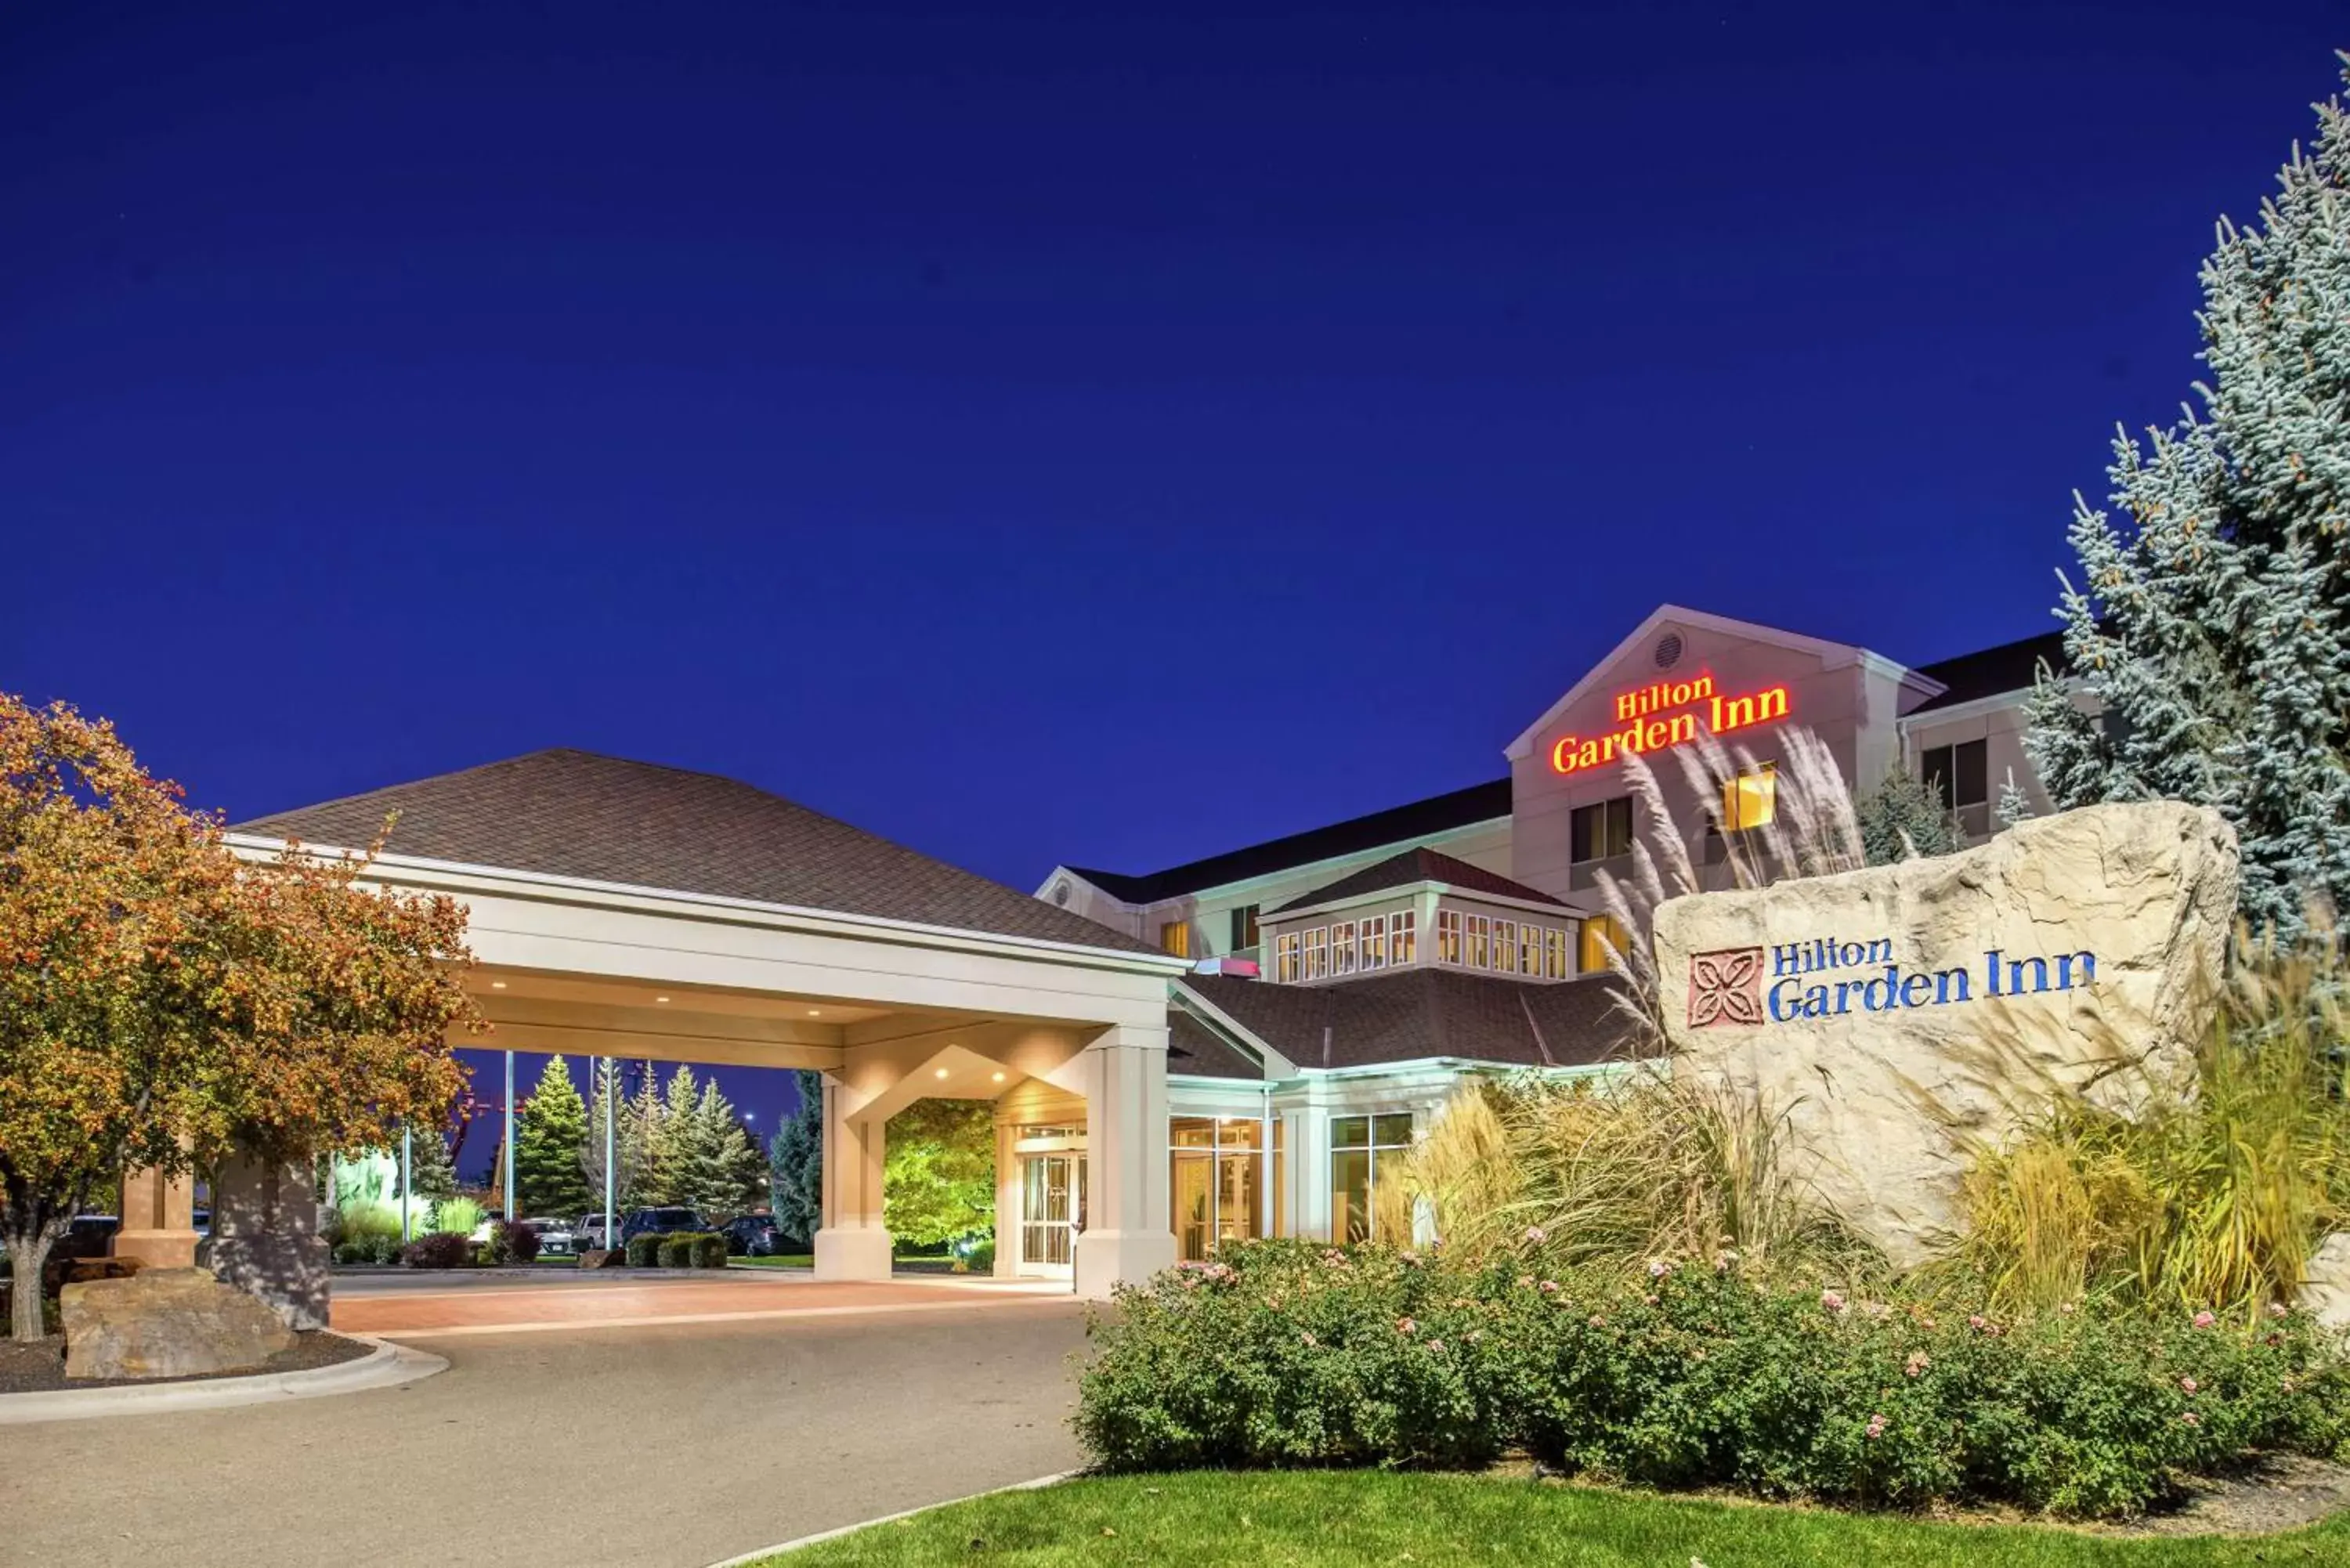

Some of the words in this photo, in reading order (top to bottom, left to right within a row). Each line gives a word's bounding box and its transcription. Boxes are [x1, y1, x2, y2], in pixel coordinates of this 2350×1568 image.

[1617, 676, 1712, 721] Hilton
[1553, 712, 1696, 773] Garden
[1710, 687, 1789, 734] Inn
[1768, 965, 1973, 1023] Garden
[1983, 948, 2100, 999] Inn
[1771, 937, 1894, 977] Hilton
